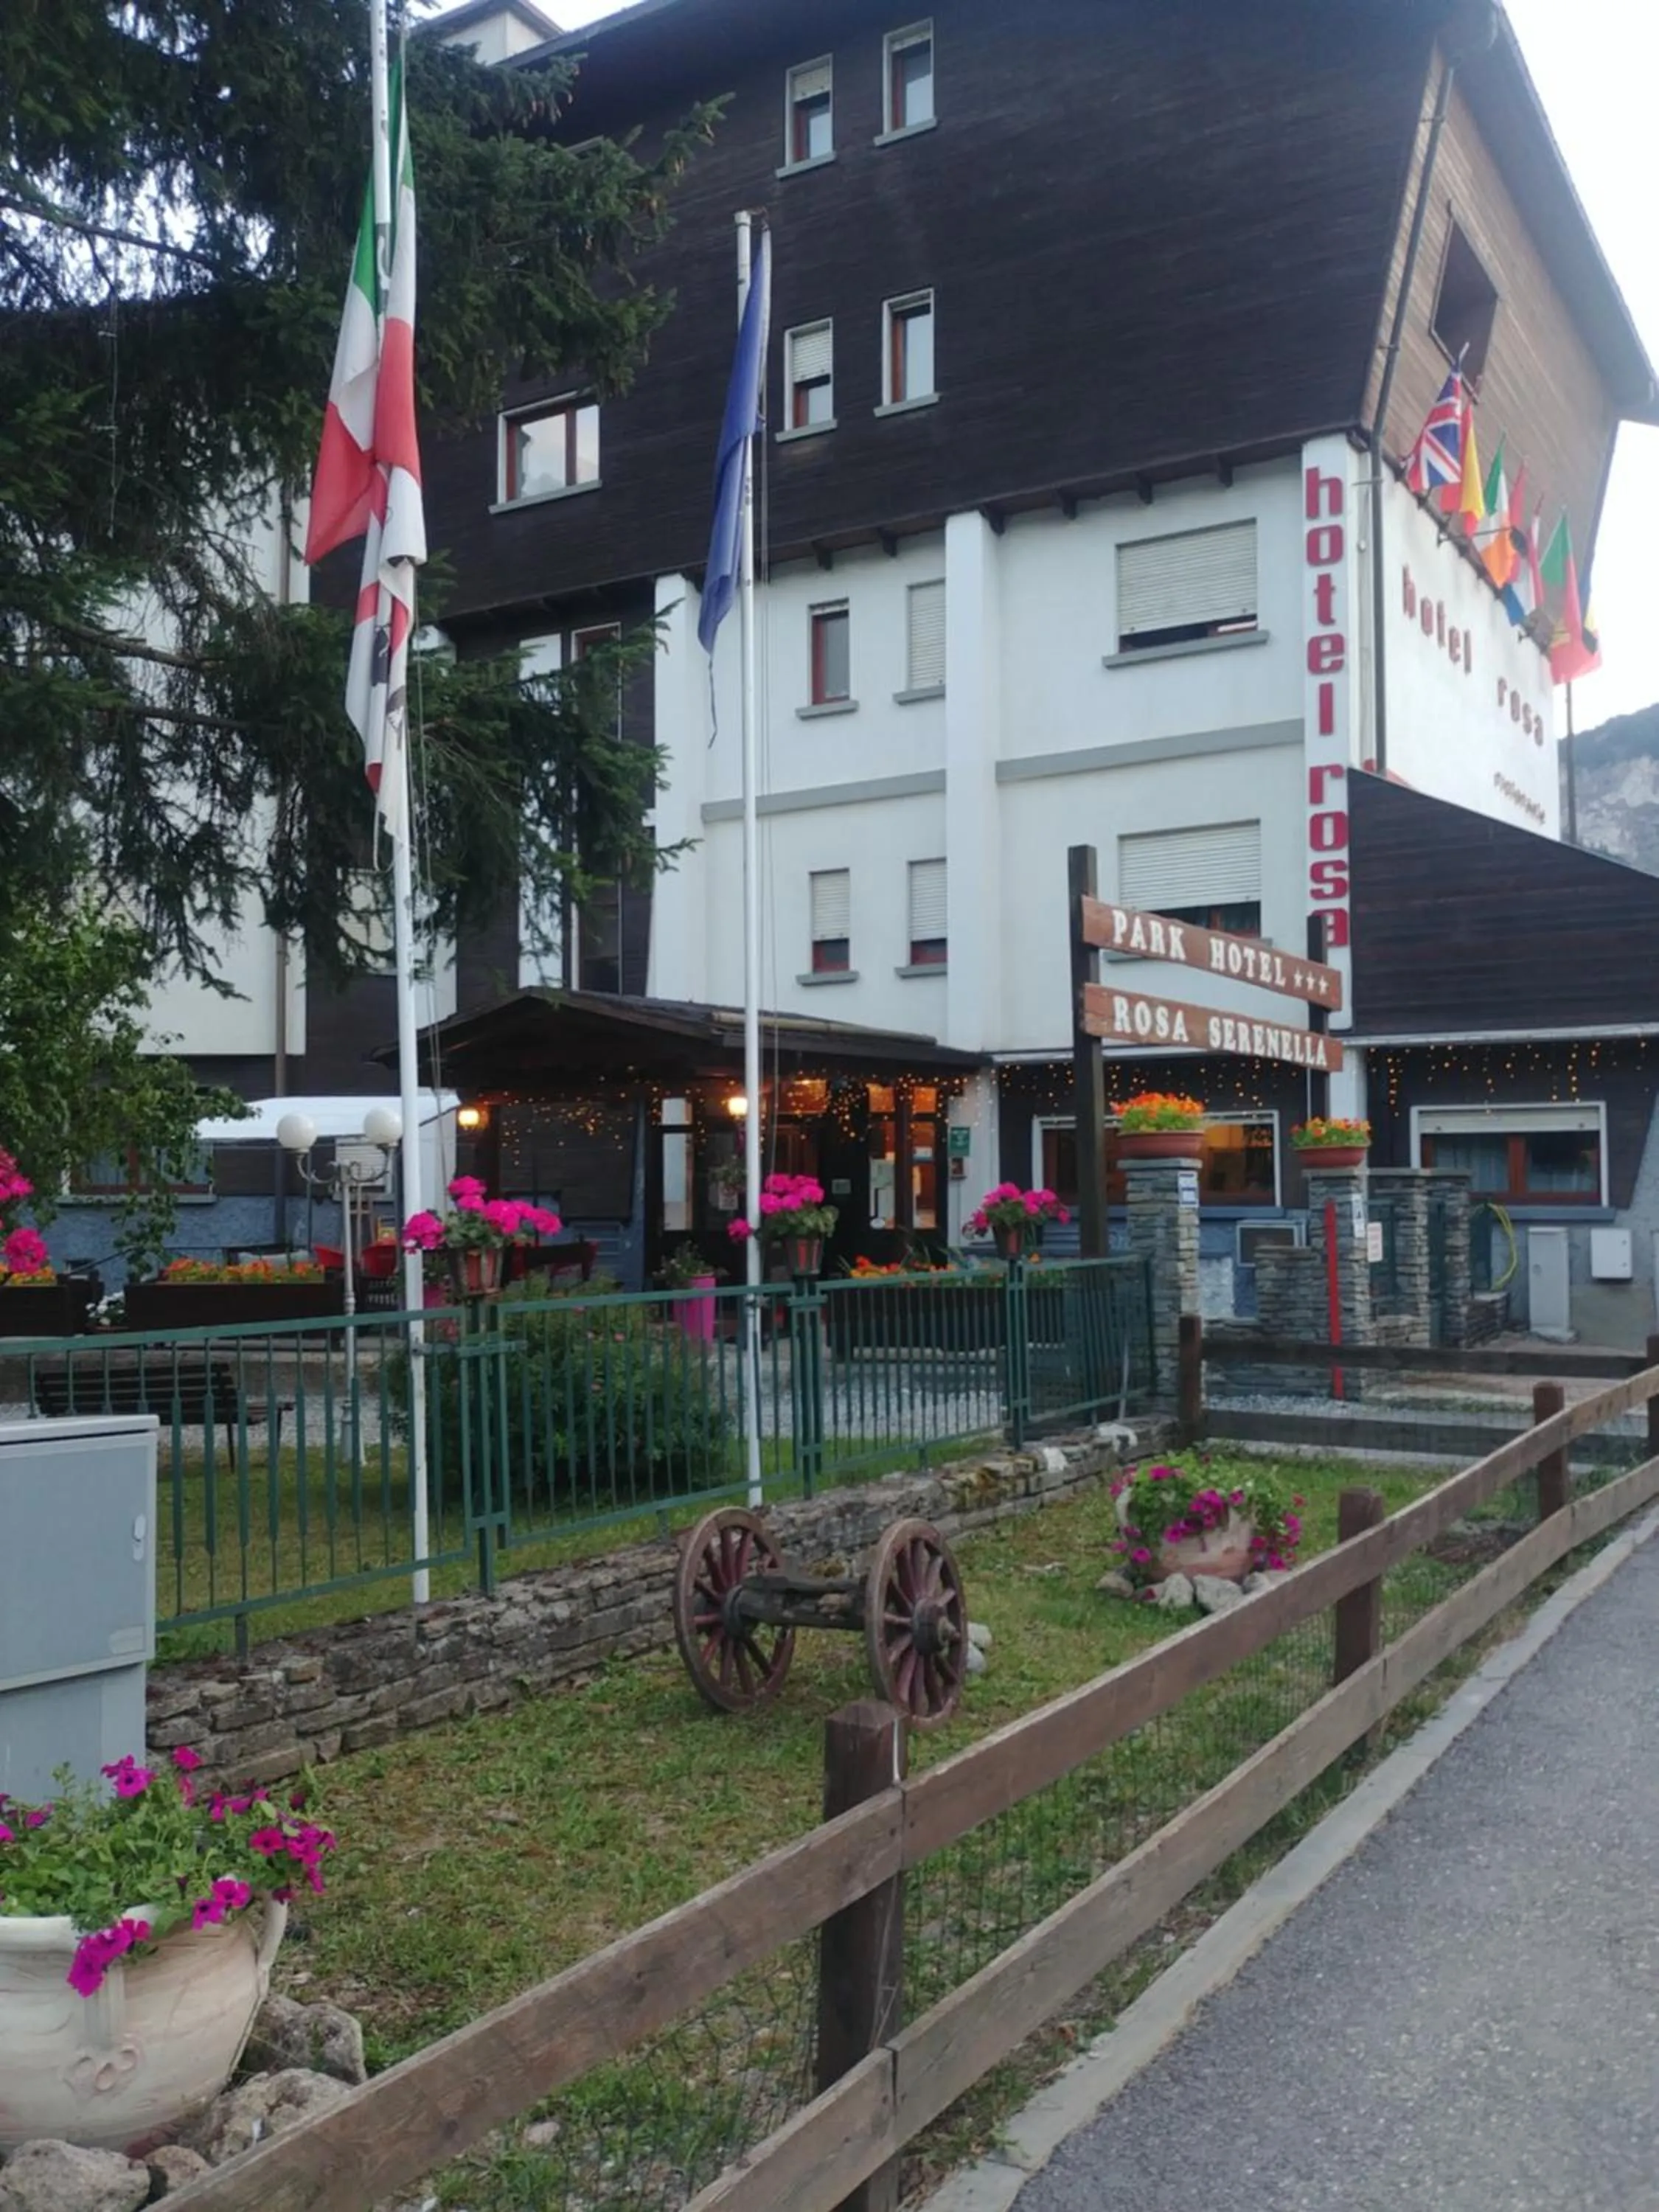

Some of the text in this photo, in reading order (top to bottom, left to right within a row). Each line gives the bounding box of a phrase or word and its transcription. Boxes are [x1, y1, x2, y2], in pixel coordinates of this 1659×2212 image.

[1306, 467, 1345, 735] hotel
[1403, 564, 1472, 675] hotel
[1498, 677, 1543, 746] rosa
[1112, 909, 1287, 987] PARK HOTEL
[1113, 995, 1327, 1067] ROSA SERENELLA
